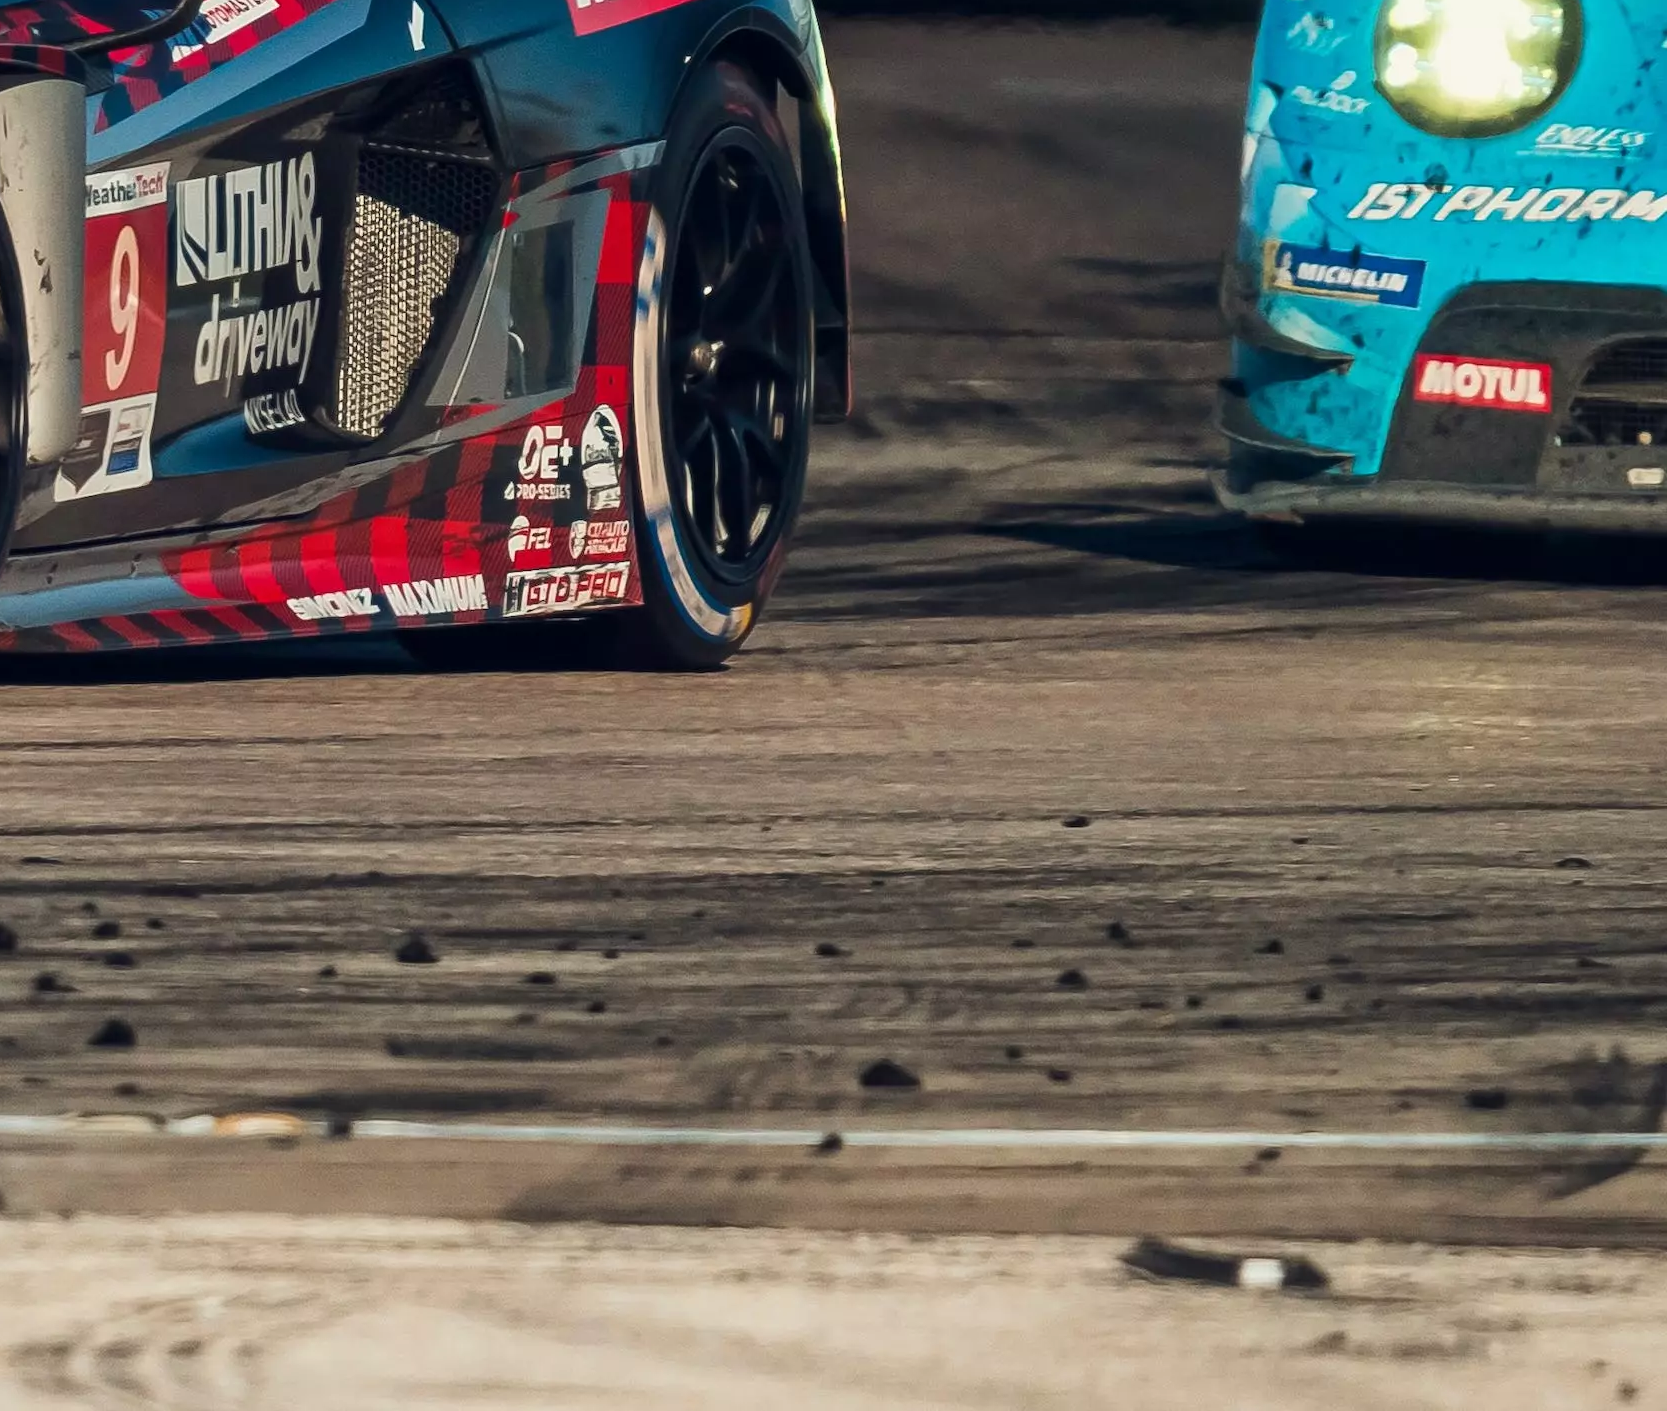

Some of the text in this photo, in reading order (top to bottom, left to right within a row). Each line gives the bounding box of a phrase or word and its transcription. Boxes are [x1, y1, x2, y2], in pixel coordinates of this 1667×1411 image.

[1433, 185, 1667, 222] PHORM
[1297, 262, 1409, 293] MICHELIN
[105, 225, 140, 391] 9
[194, 278, 320, 398] driveway
[1419, 360, 1547, 406] MOTUL
